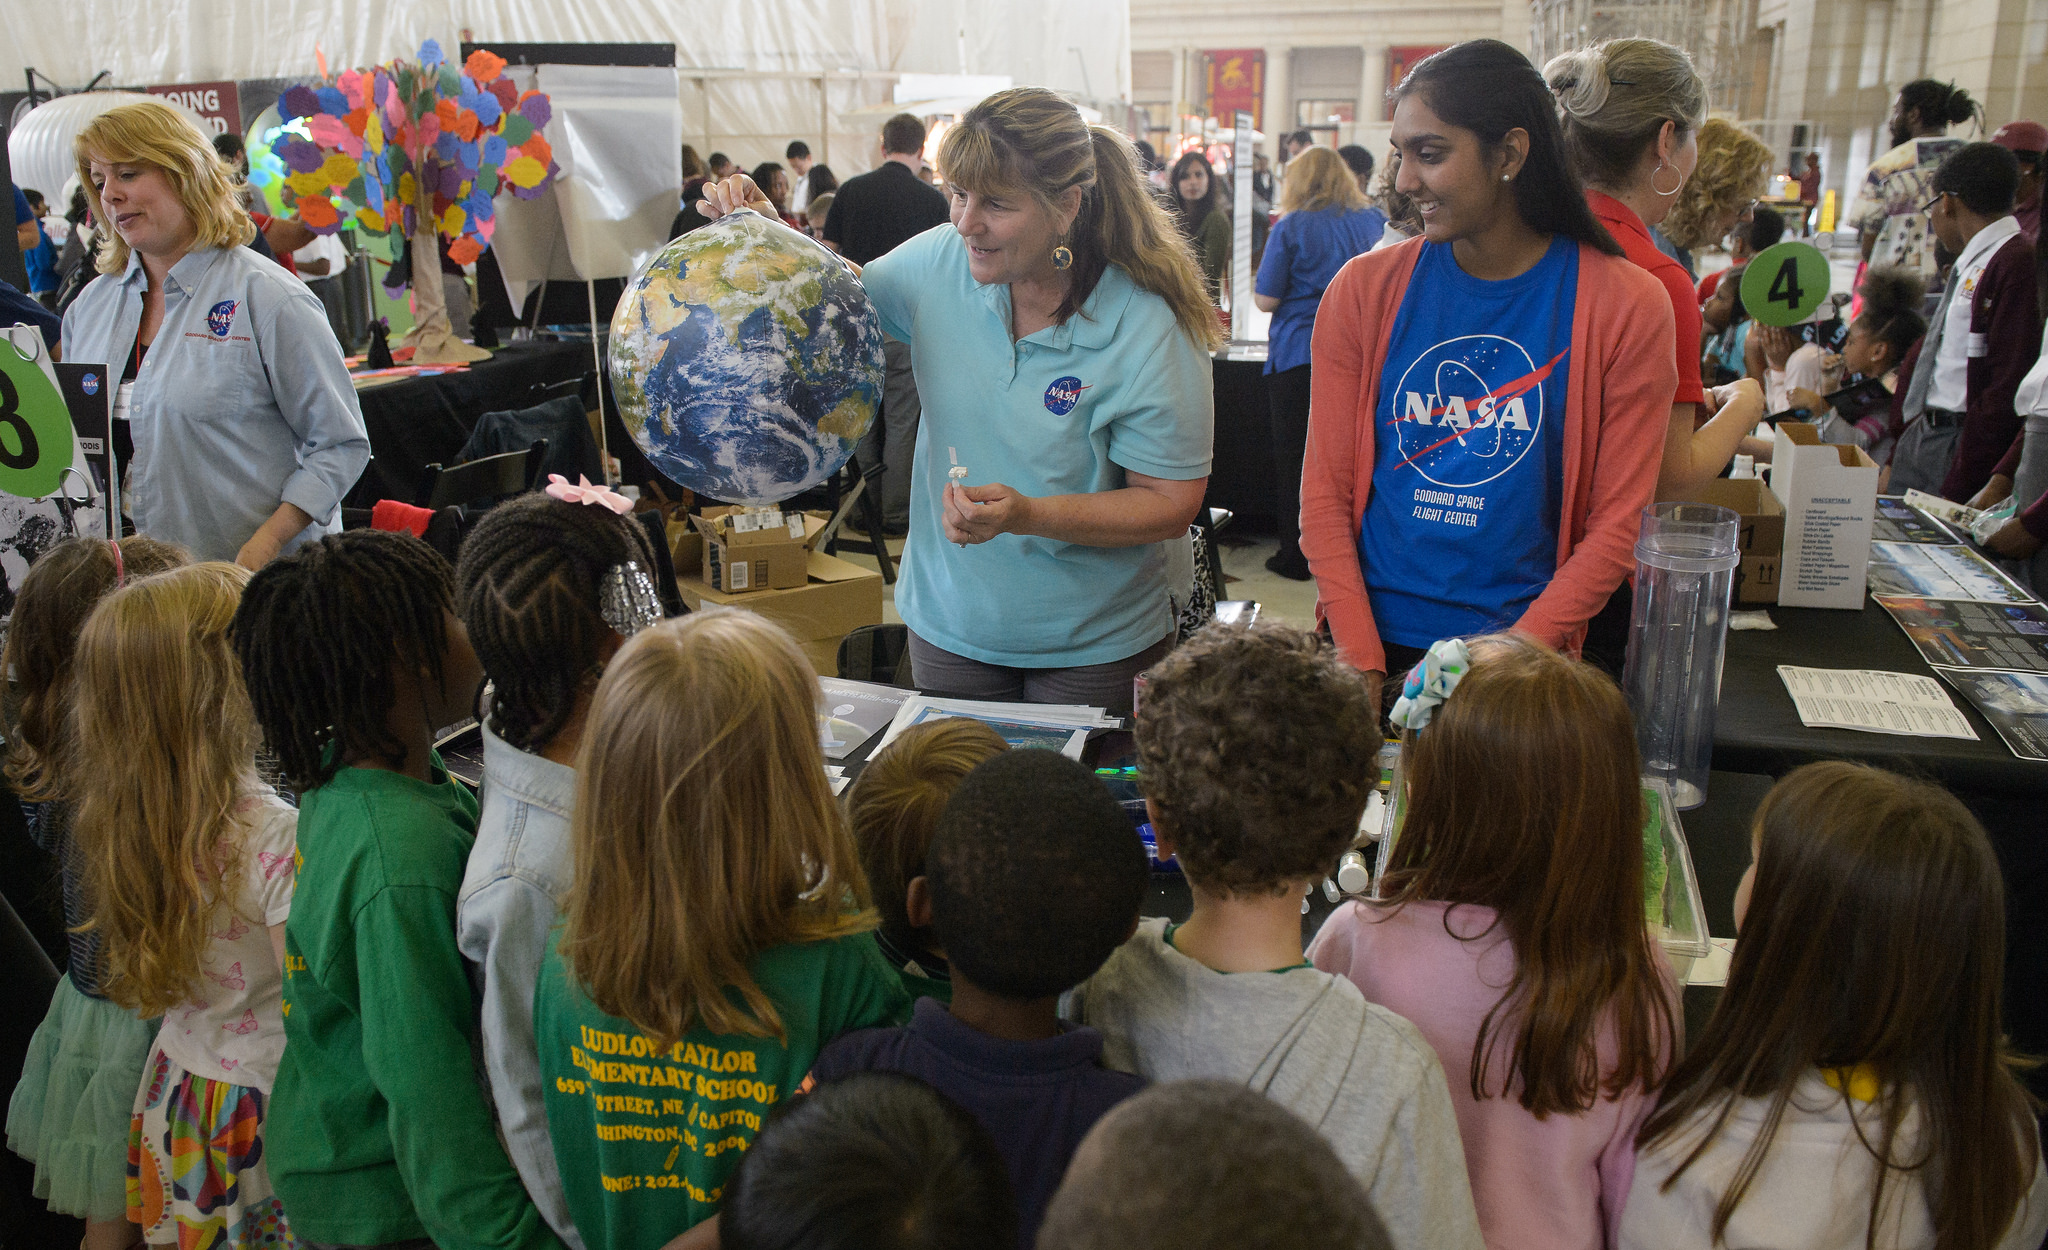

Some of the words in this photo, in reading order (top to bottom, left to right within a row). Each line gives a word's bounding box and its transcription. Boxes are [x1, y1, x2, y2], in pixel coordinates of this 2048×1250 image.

[155, 89, 221, 112] OING
[1767, 256, 1804, 310] 4
[1048, 386, 1077, 403] NASA
[1404, 391, 1532, 431] NASA
[80, 442, 100, 450] ODIS
[1413, 488, 1454, 506] GODDARD
[1456, 494, 1485, 511] SPACE
[1412, 505, 1443, 522] FLIGHT
[1444, 510, 1478, 527] CENTER
[571, 1045, 694, 1091] ELMENTARY
[696, 1074, 779, 1105] SCHOOL
[556, 1076, 585, 1095] 659
[595, 1094, 660, 1118] STREET,
[662, 1098, 685, 1116] NE
[596, 1123, 683, 1143] SHINGTON,
[704, 1136, 751, 1157] 2000
[600, 1172, 641, 1193] ONE:
